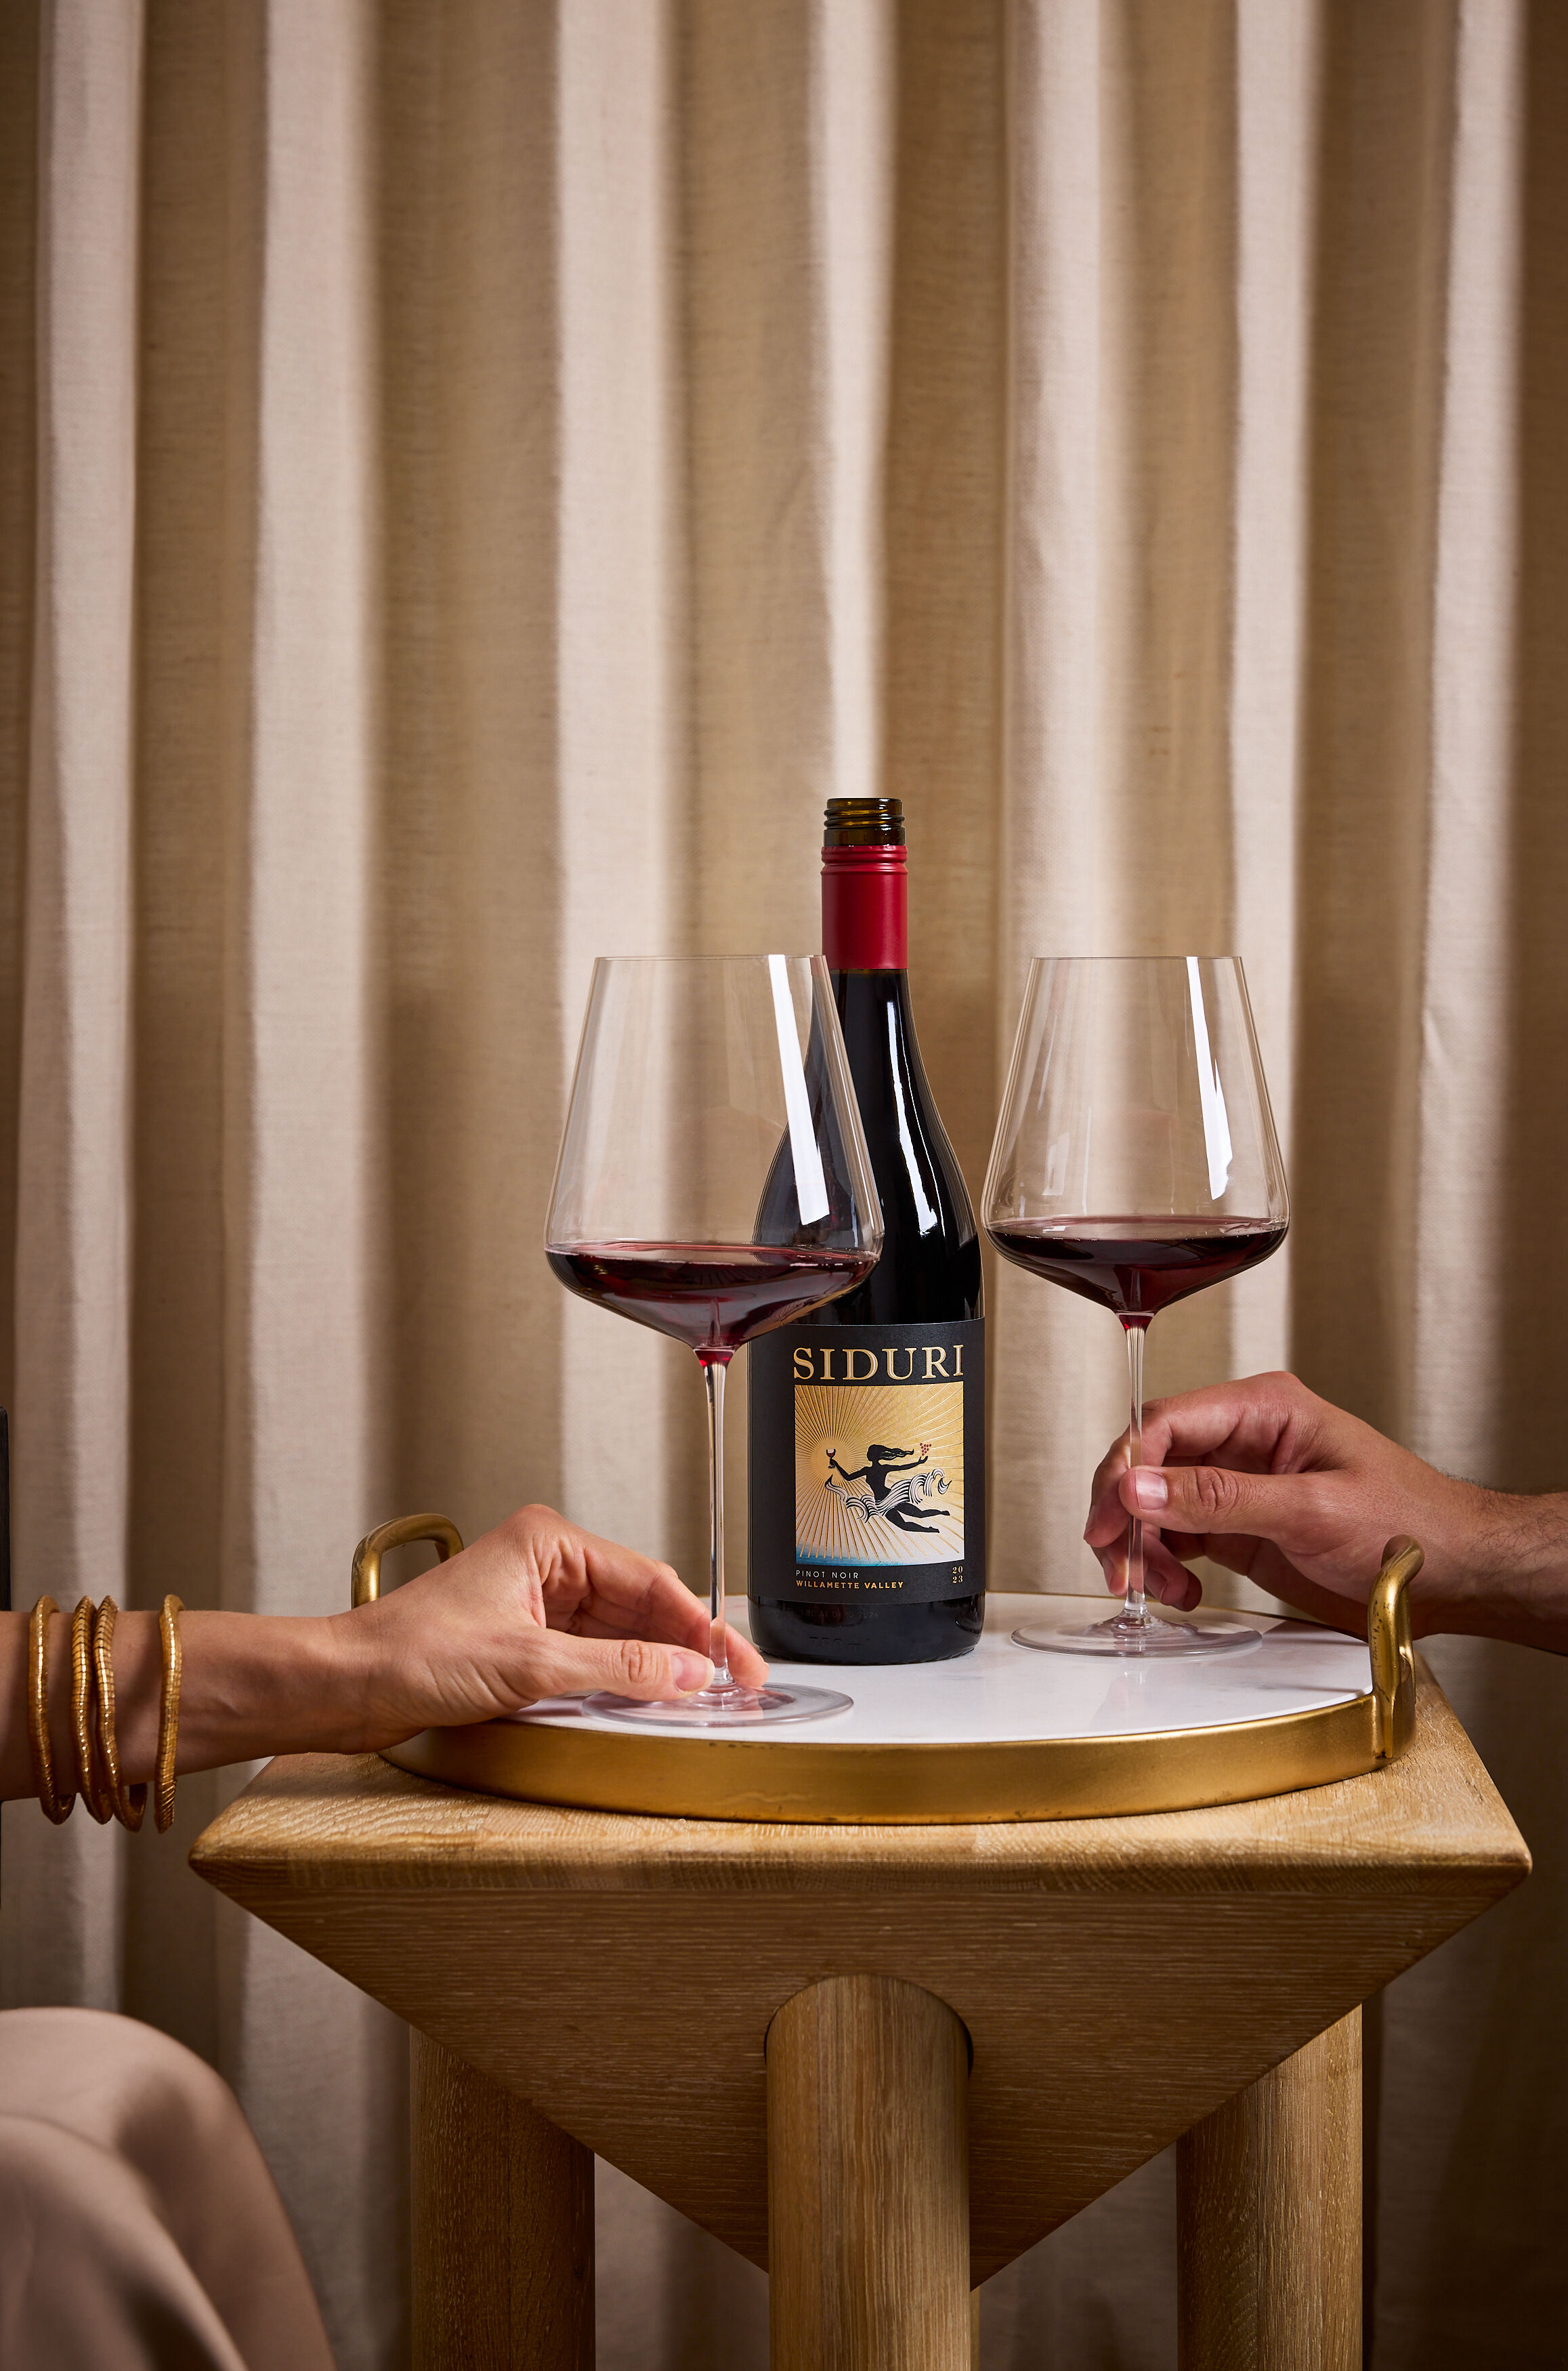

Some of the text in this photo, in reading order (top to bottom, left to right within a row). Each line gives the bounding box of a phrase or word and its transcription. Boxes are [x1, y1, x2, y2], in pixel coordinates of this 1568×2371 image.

[793, 1344, 964, 1381] SIDURI
[796, 1570, 825, 1578] PINOT
[952, 1566, 963, 1574] 20
[796, 1580, 904, 1589] WILLAMETTE VALLEY
[952, 1575, 963, 1585] 23
